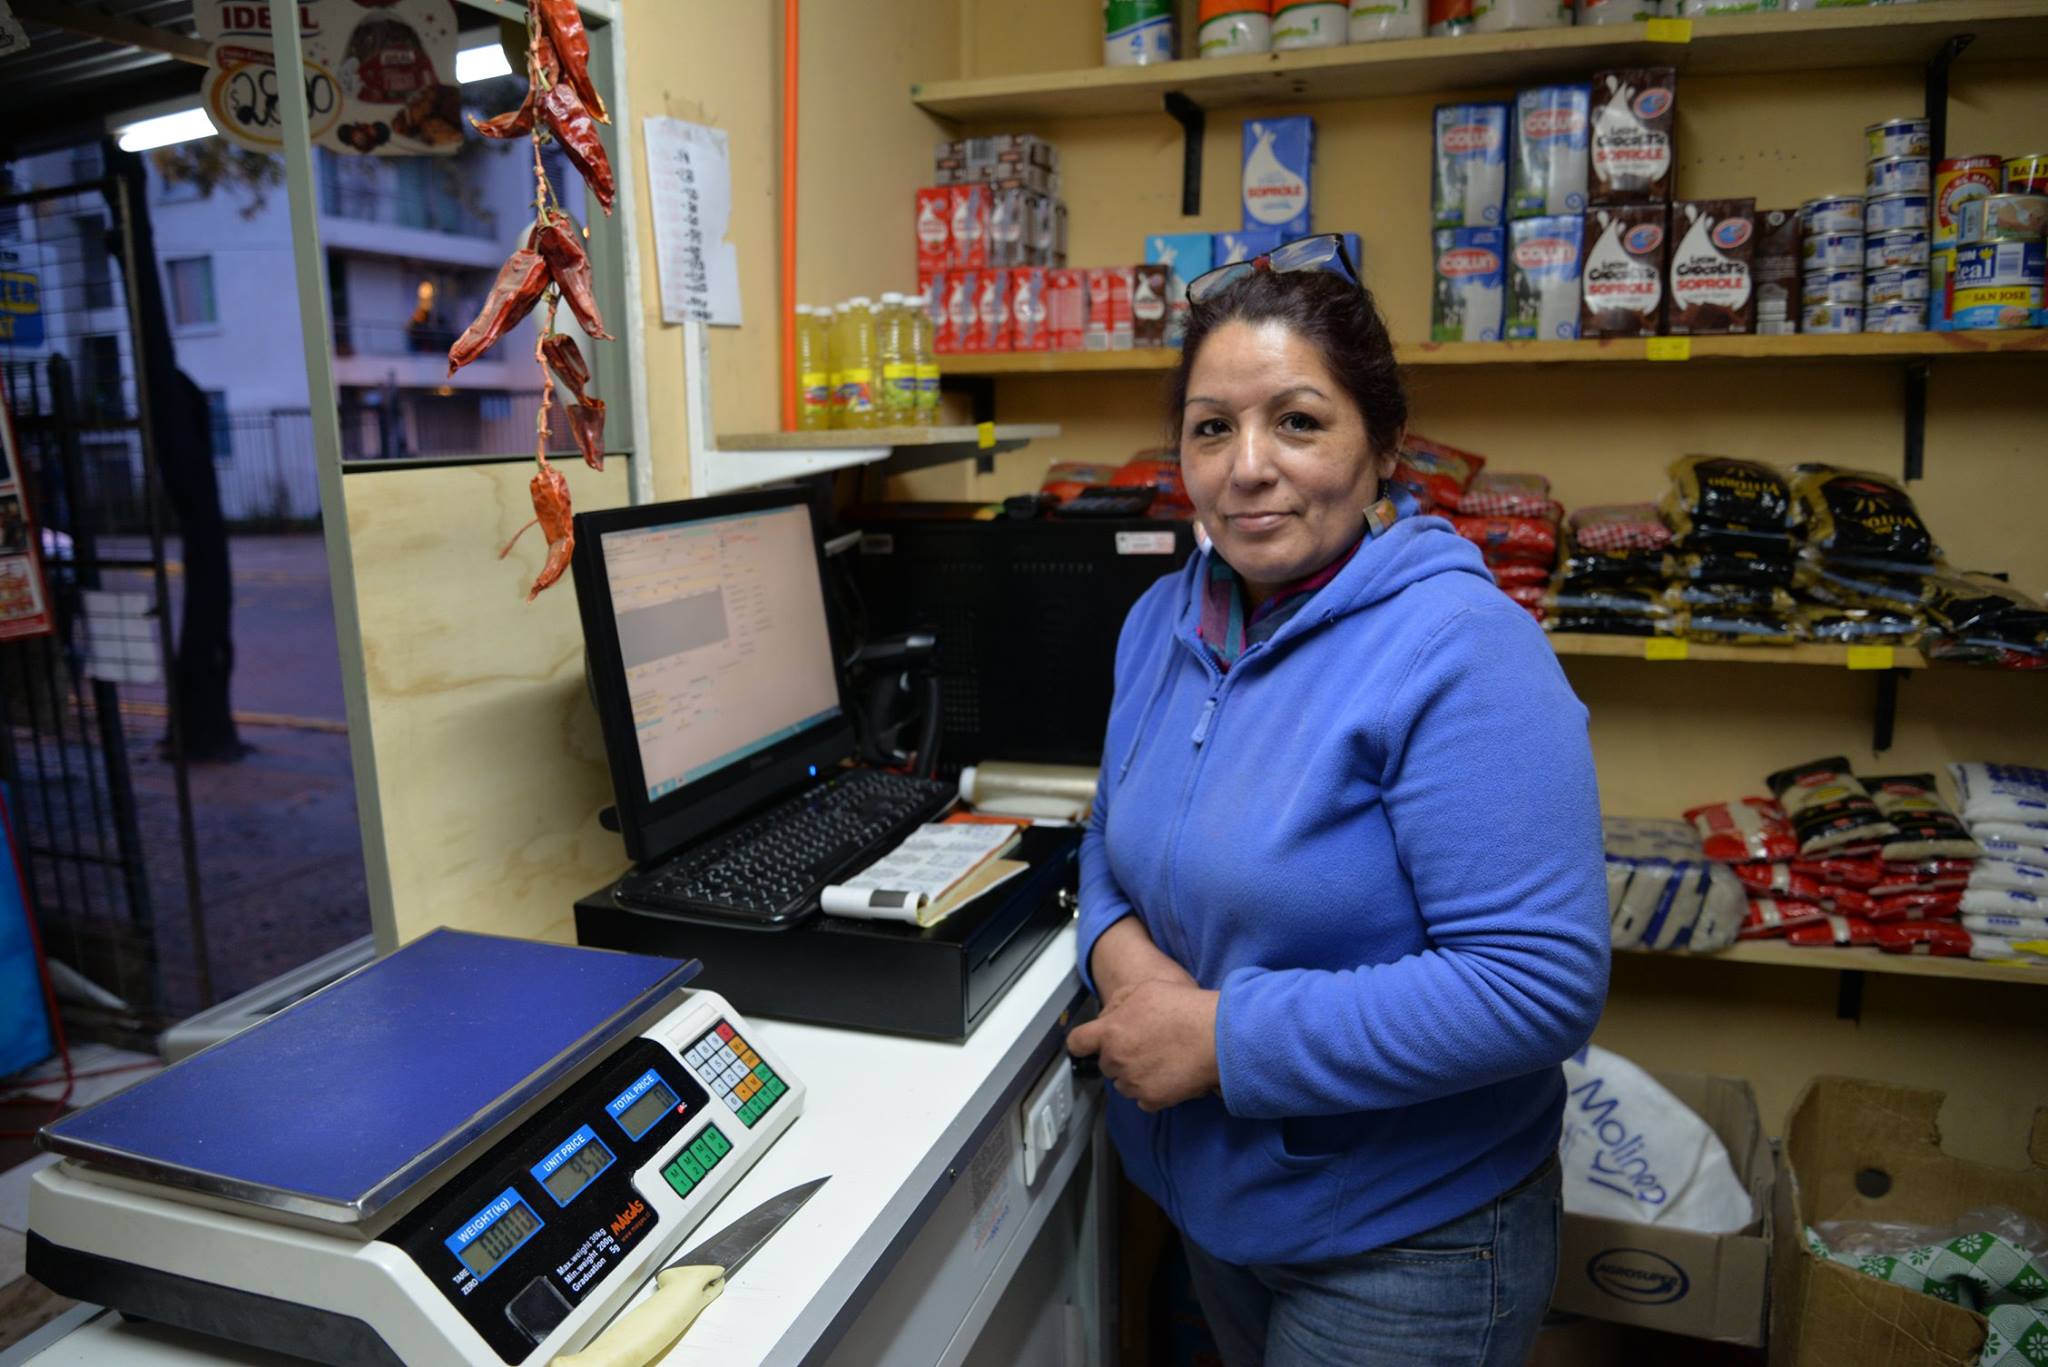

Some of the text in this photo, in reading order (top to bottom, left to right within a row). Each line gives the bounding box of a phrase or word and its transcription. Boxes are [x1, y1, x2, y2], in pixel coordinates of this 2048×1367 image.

[223, 6, 319, 29] IDEL
[1676, 277, 1743, 291] SOPROLE
[612, 1074, 655, 1111] TOTAL PRICE
[542, 1133, 586, 1172] UNIT PRICE
[457, 1198, 512, 1244] WEIGHT(kg)
[589, 1228, 607, 1244] 30kg
[596, 1235, 615, 1252] 200g
[452, 1267, 471, 1284] TARE
[571, 1244, 621, 1292] Graduation 5g
[460, 1278, 479, 1295] ZERO
